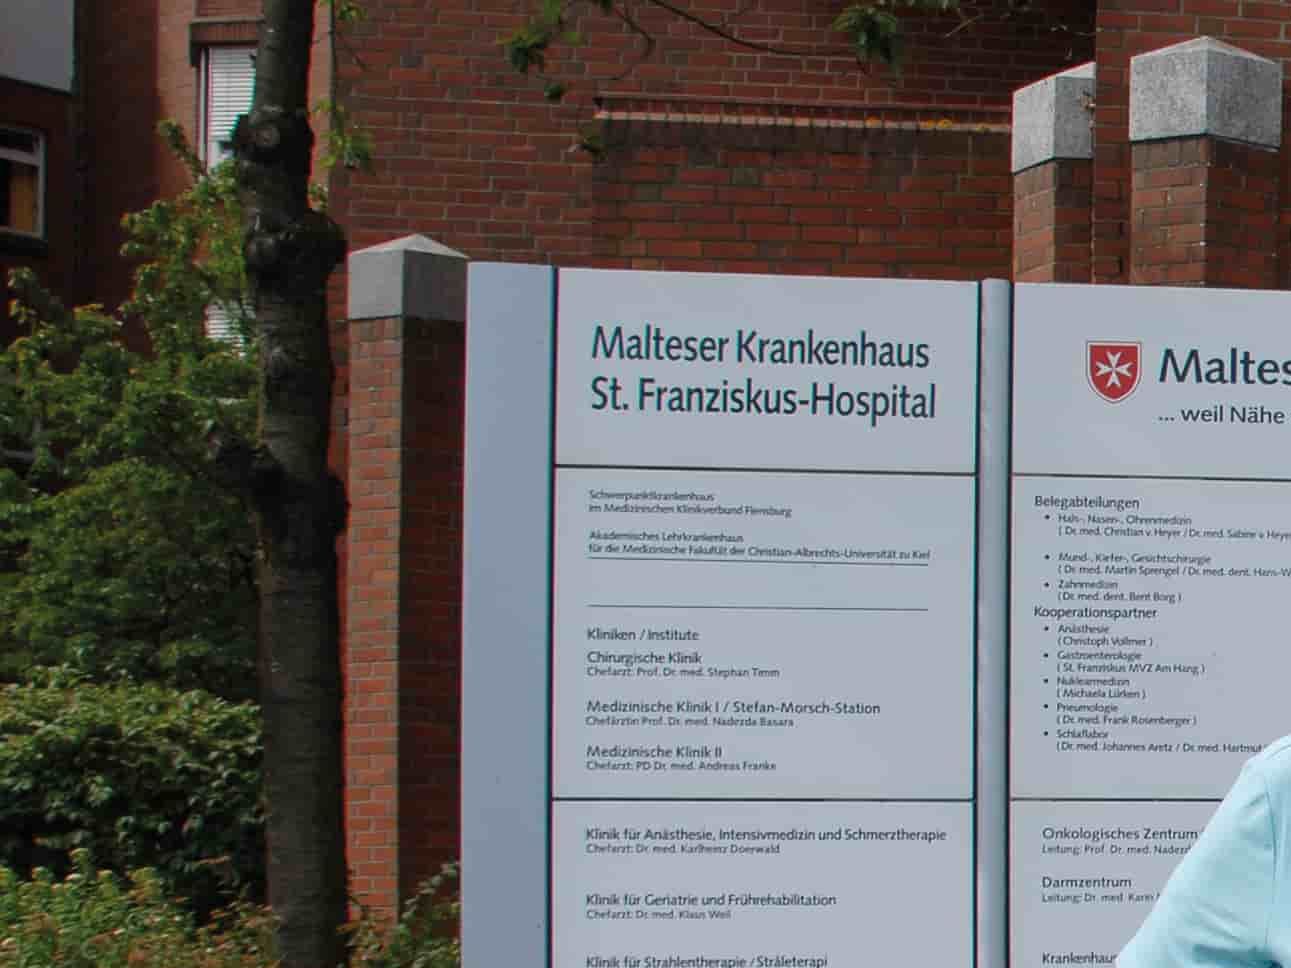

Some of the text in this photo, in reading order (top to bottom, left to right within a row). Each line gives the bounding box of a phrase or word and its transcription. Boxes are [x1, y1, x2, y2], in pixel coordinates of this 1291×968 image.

[591, 324, 930, 368] Malteser Krankenhaus
[591, 376, 937, 427] St. Franziskus-Hospital
[1181, 406, 1224, 424] weil
[1230, 407, 1285, 425] Nähe
[1034, 496, 1140, 511] Belegabteilungen
[1105, 566, 1137, 576] Martin
[1034, 606, 1157, 621] Kooperationspartner
[587, 628, 700, 641] Kliniken Institute
[587, 651, 702, 667] Chirurgische Klinik
[587, 700, 673, 713] Medizinische
[677, 701, 711, 713] Klinik
[733, 701, 881, 715] Stefan-Morsch-Station
[1057, 703, 1119, 714] Pneumologie
[587, 745, 673, 758] Medizinische
[676, 746, 711, 758] Klinik
[586, 827, 947, 844] Klinik für Anästhesie, Intensivmedizin und Schmerztherapie
[1042, 827, 1199, 841] Onkologisches Zentrum
[1042, 877, 1132, 889] Darmzentrum
[586, 894, 837, 907] Klinik für Geriatrie und Frührehabilitation
[679, 910, 706, 920] Klaus
[586, 956, 620, 968] Klinik
[624, 956, 641, 968] für
